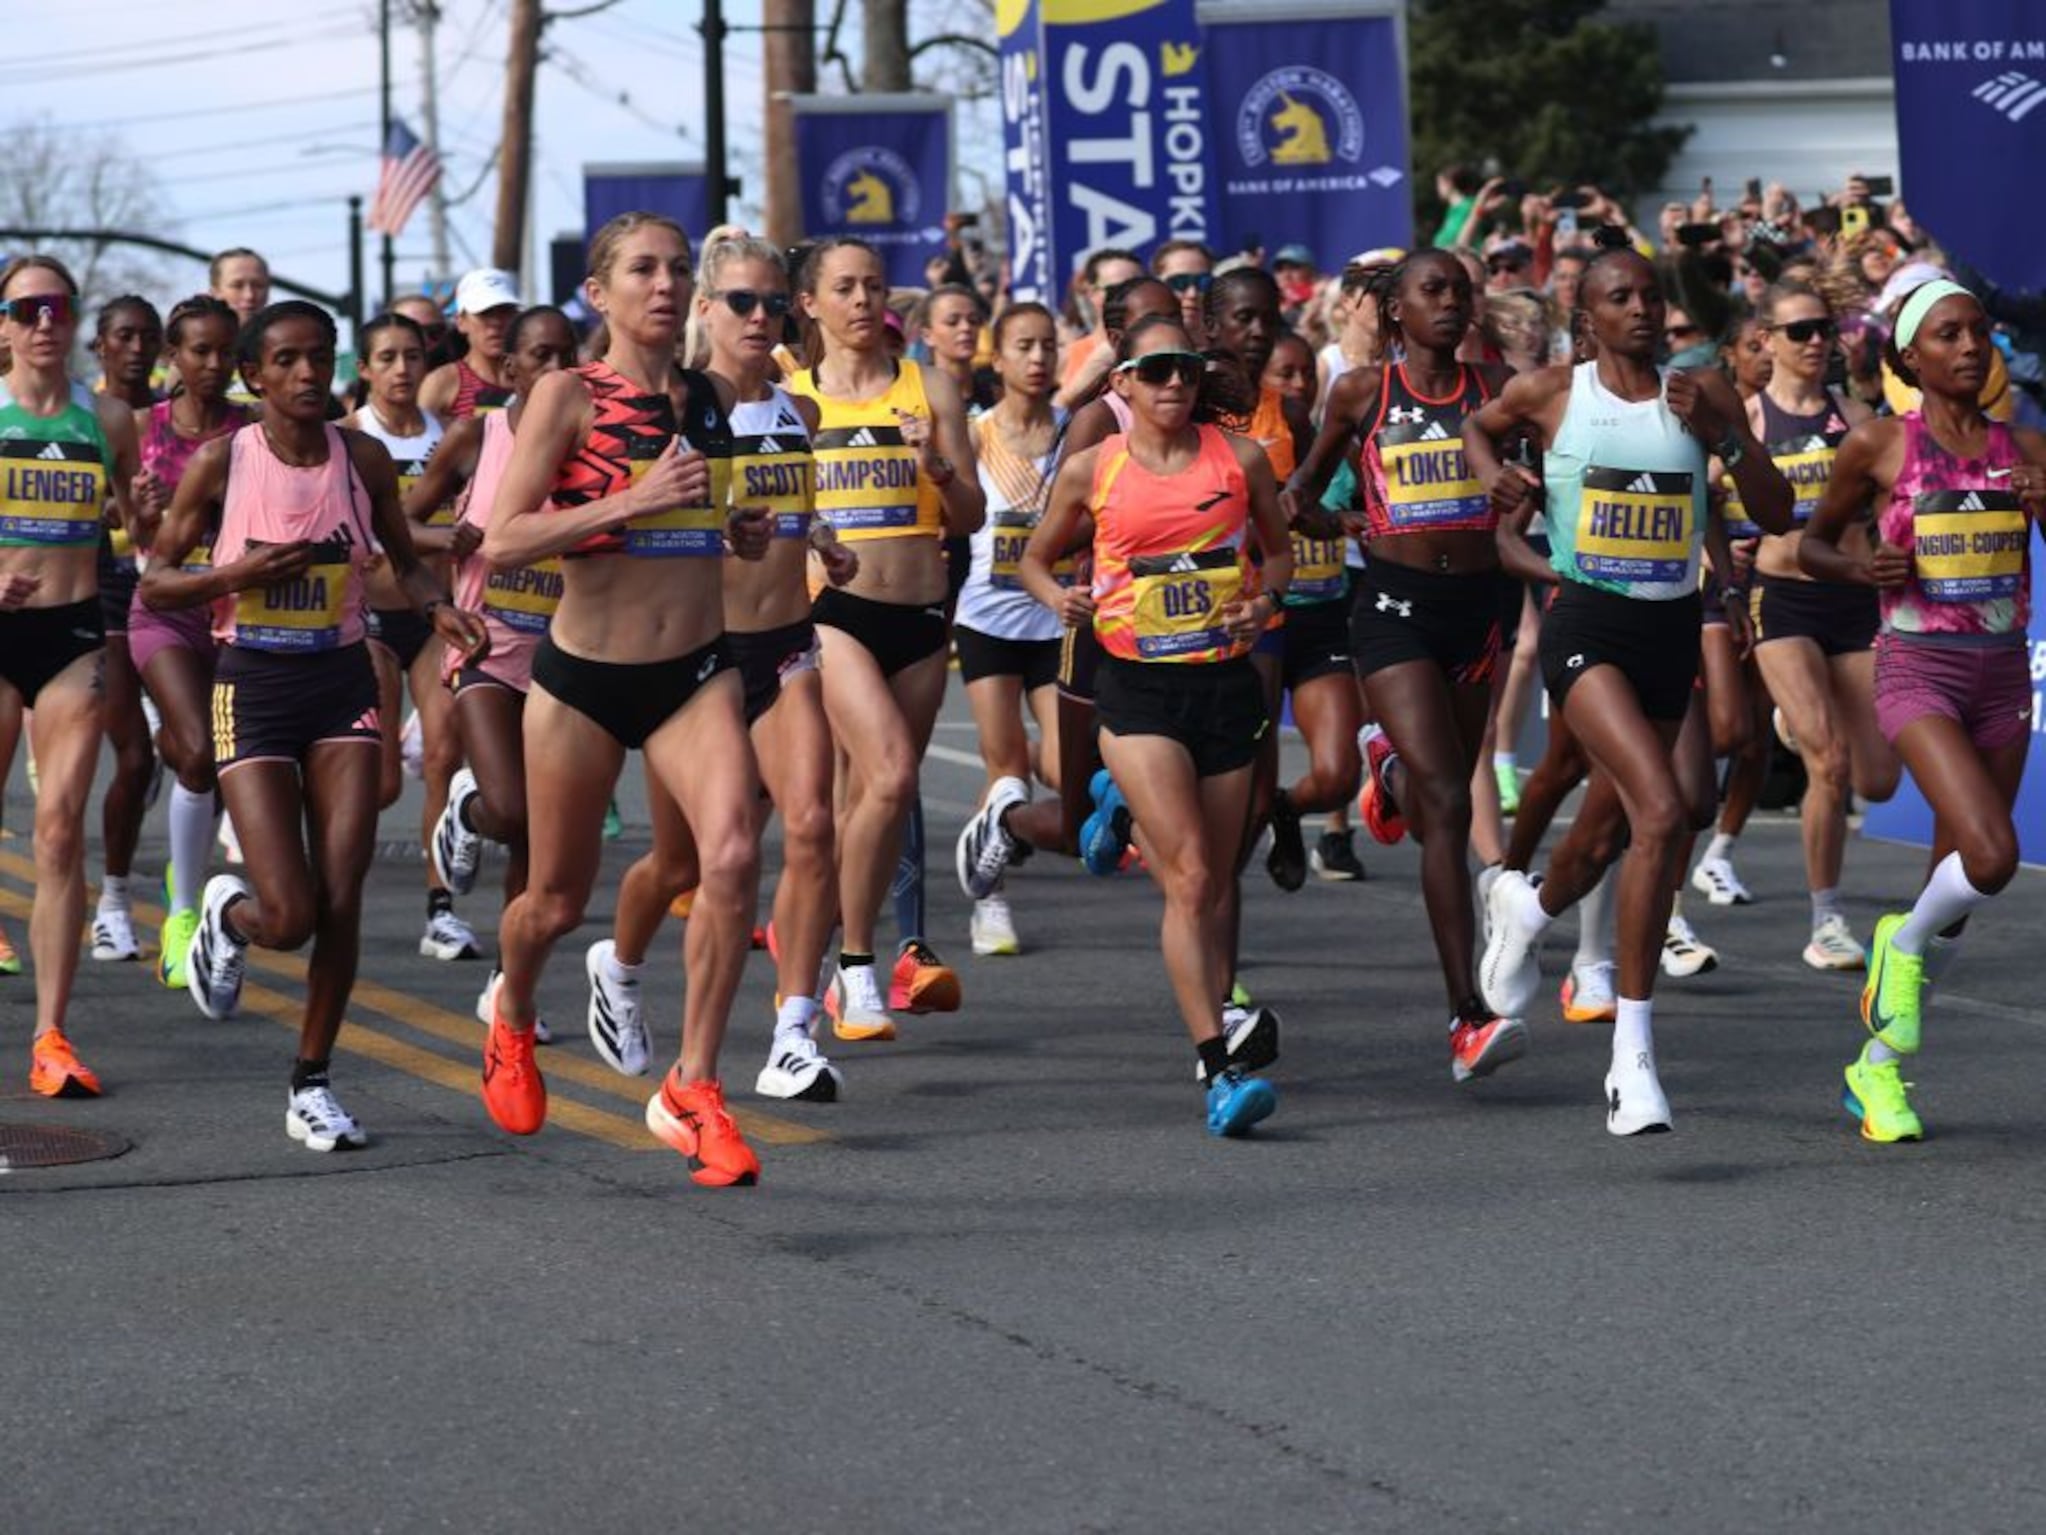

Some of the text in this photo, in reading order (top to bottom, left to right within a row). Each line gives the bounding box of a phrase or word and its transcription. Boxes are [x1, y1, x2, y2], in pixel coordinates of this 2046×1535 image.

[1902, 42, 1967, 60] BANK
[1974, 41, 2004, 60] OF
[1227, 175, 1368, 195] BANK OF AMERICA
[7, 467, 96, 504] LENGER
[745, 463, 808, 497] SCOTT
[815, 458, 917, 492] SIMPSON
[1396, 450, 1478, 487] LOKED
[1590, 500, 1684, 543] HELLEN
[1163, 579, 1211, 618] DES
